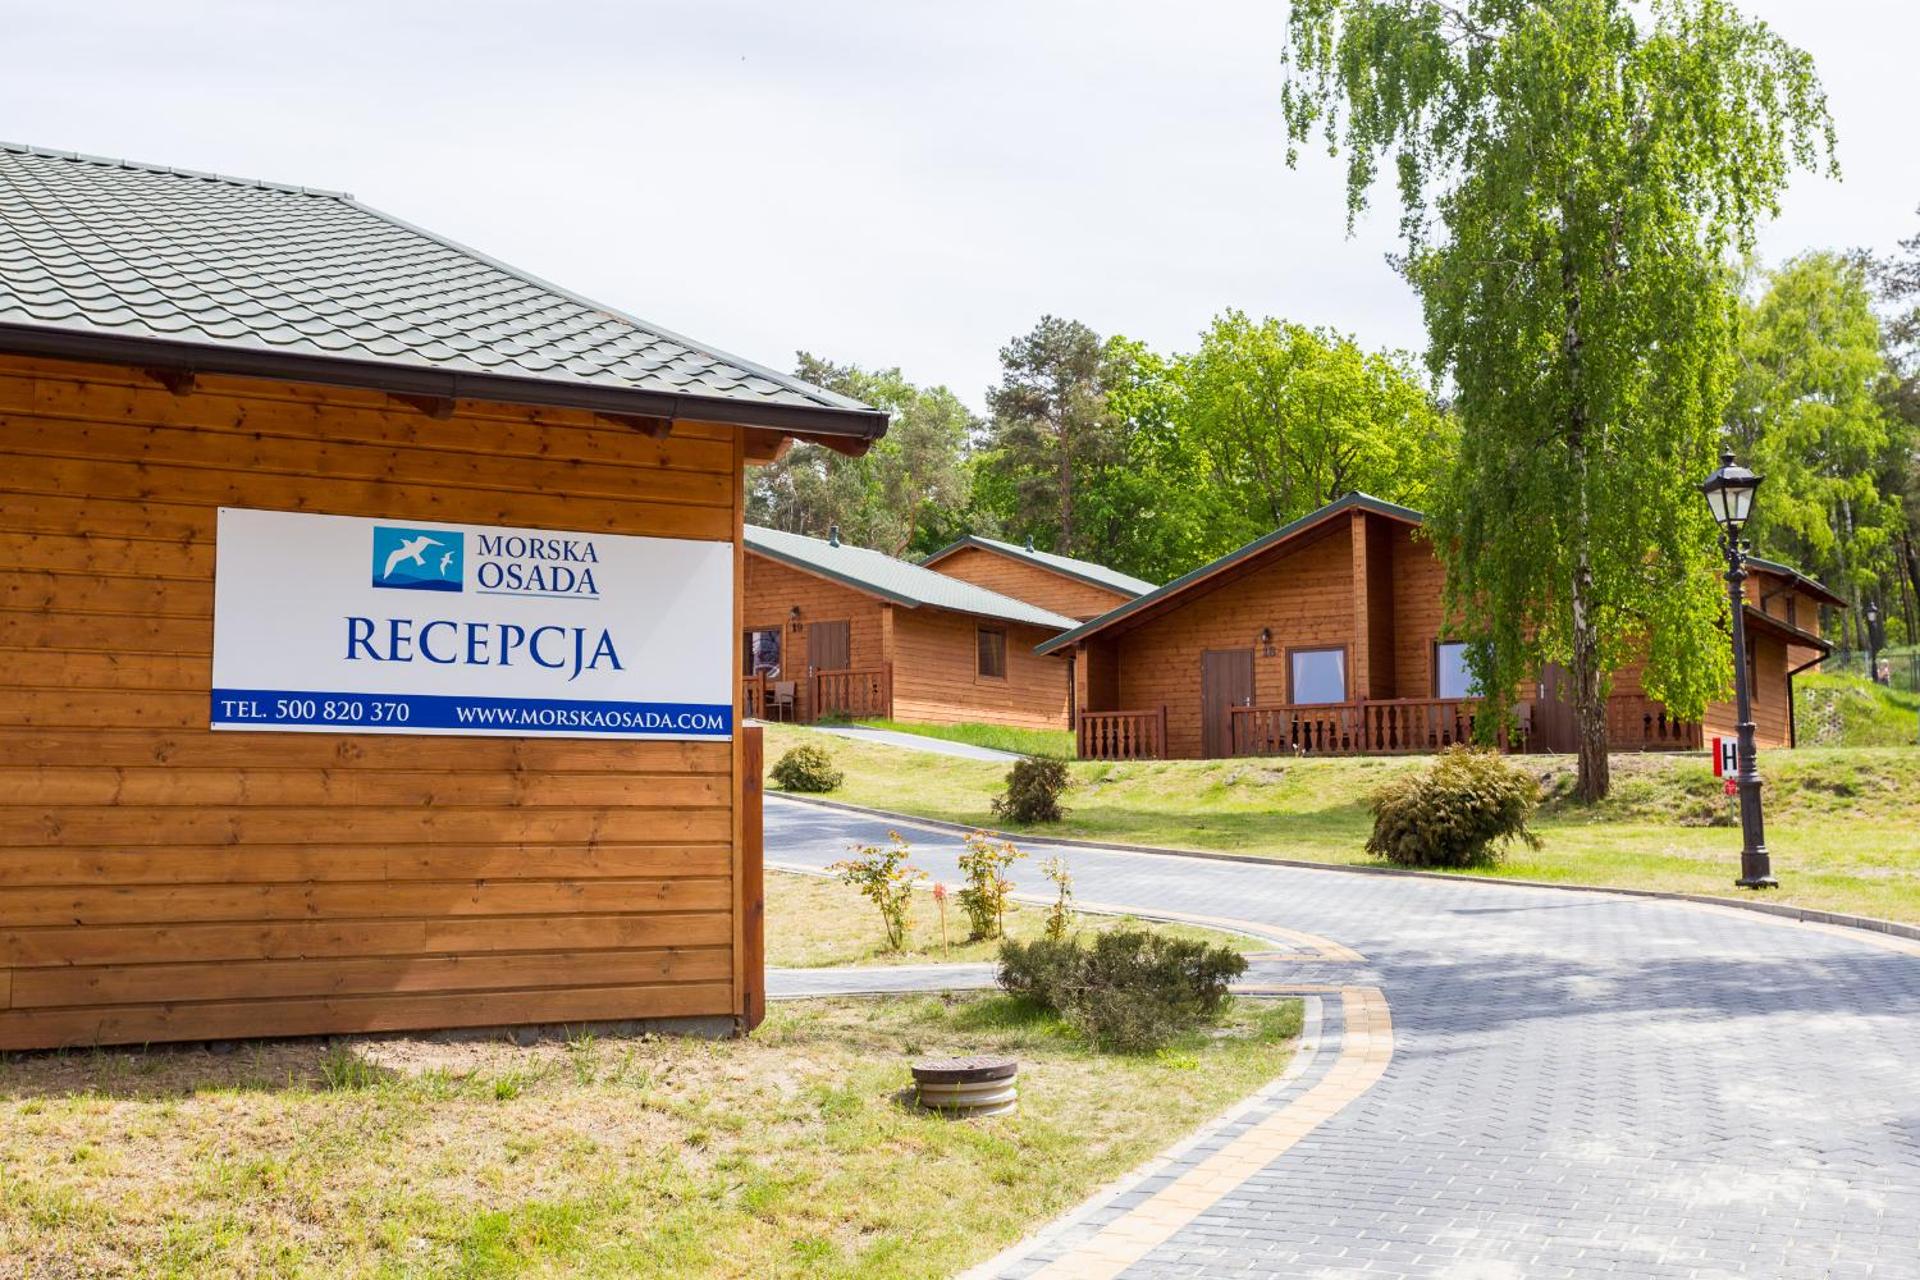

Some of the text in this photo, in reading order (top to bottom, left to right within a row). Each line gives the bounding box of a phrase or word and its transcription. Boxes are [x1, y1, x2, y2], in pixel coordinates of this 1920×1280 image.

[478, 534, 599, 562] MORSKA
[478, 562, 599, 594] OSADA
[344, 617, 625, 682] RECEPCJA
[221, 699, 409, 722] TEL. 500 820 370
[456, 706, 723, 730] WWW.MORSKAOSADA.COM
[1722, 743, 1738, 771] H
